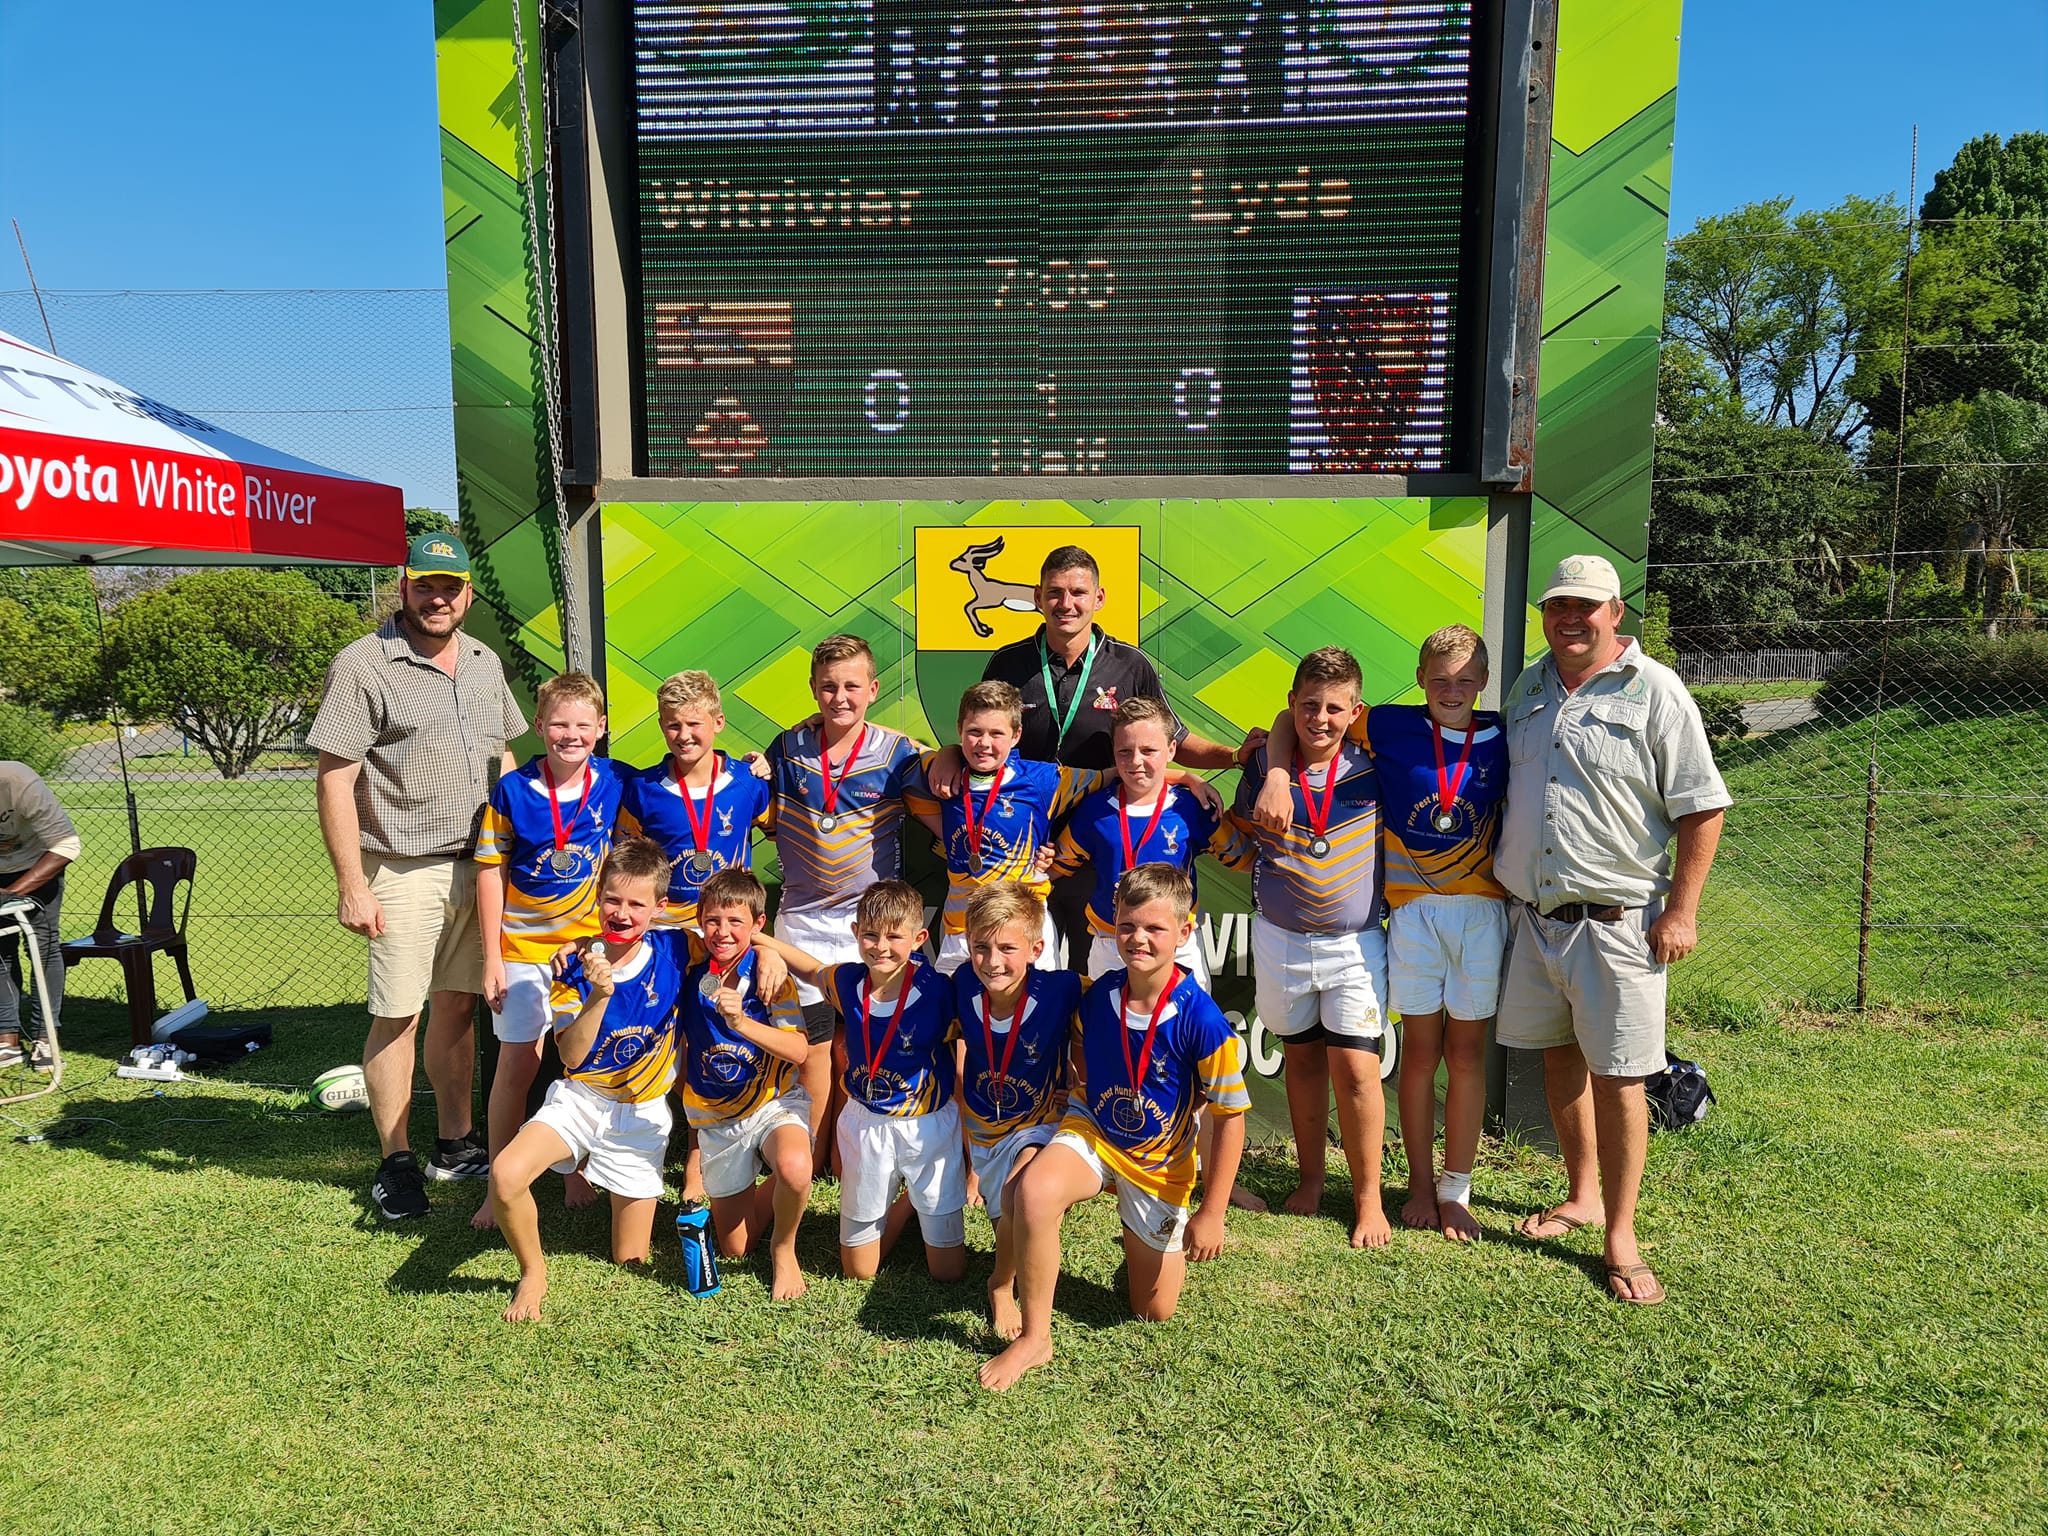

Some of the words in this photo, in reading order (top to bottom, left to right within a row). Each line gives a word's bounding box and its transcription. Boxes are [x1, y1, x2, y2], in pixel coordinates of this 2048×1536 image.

[1191, 165, 1354, 235] Lyde
[864, 368, 911, 433] 0
[1173, 367, 1223, 431] 0
[130, 458, 236, 516] White
[245, 475, 316, 525] River
[610, 1025, 643, 1039] Hunters
[326, 1087, 368, 1101] GILBE
